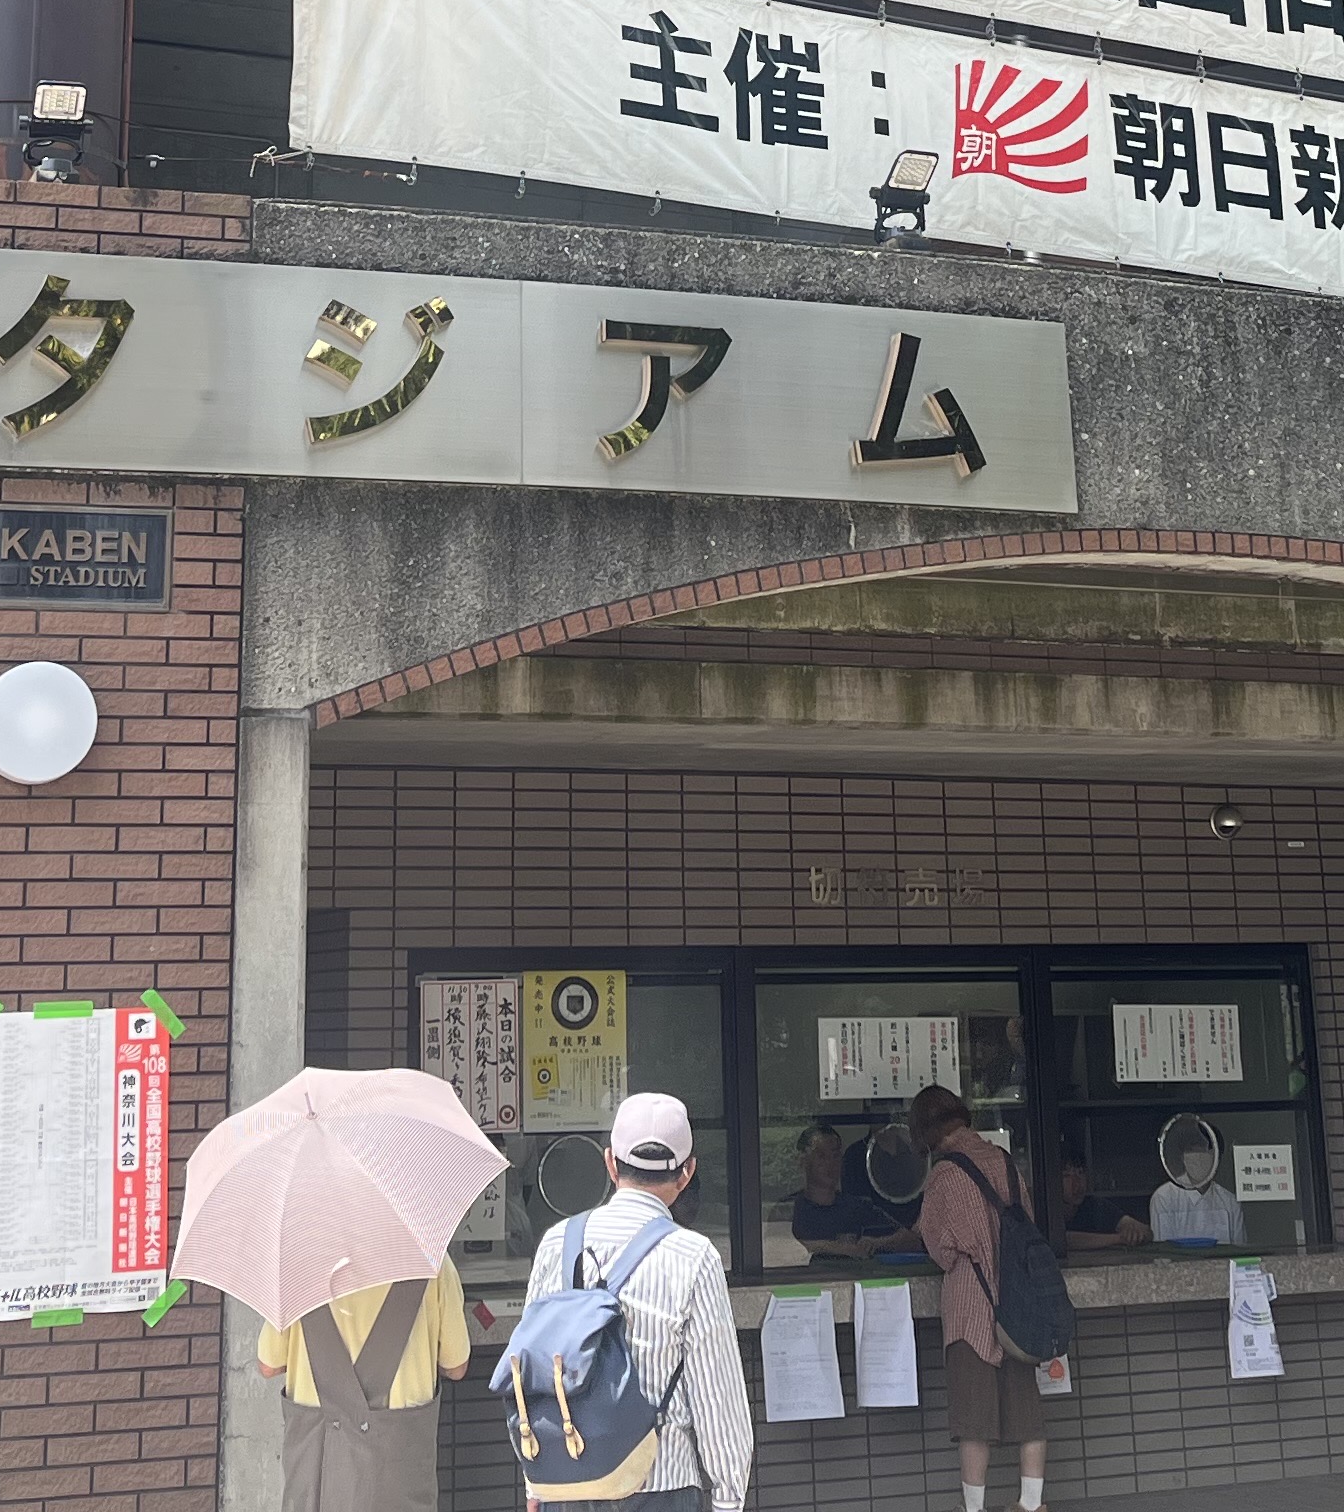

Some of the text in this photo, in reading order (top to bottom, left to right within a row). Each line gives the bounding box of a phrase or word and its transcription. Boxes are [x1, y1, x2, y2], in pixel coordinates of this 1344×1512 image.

[29, 565, 147, 588] STADIUM
[497, 997, 516, 1084] 本日の試合
[121, 1074, 136, 1167] 神奈川大会
